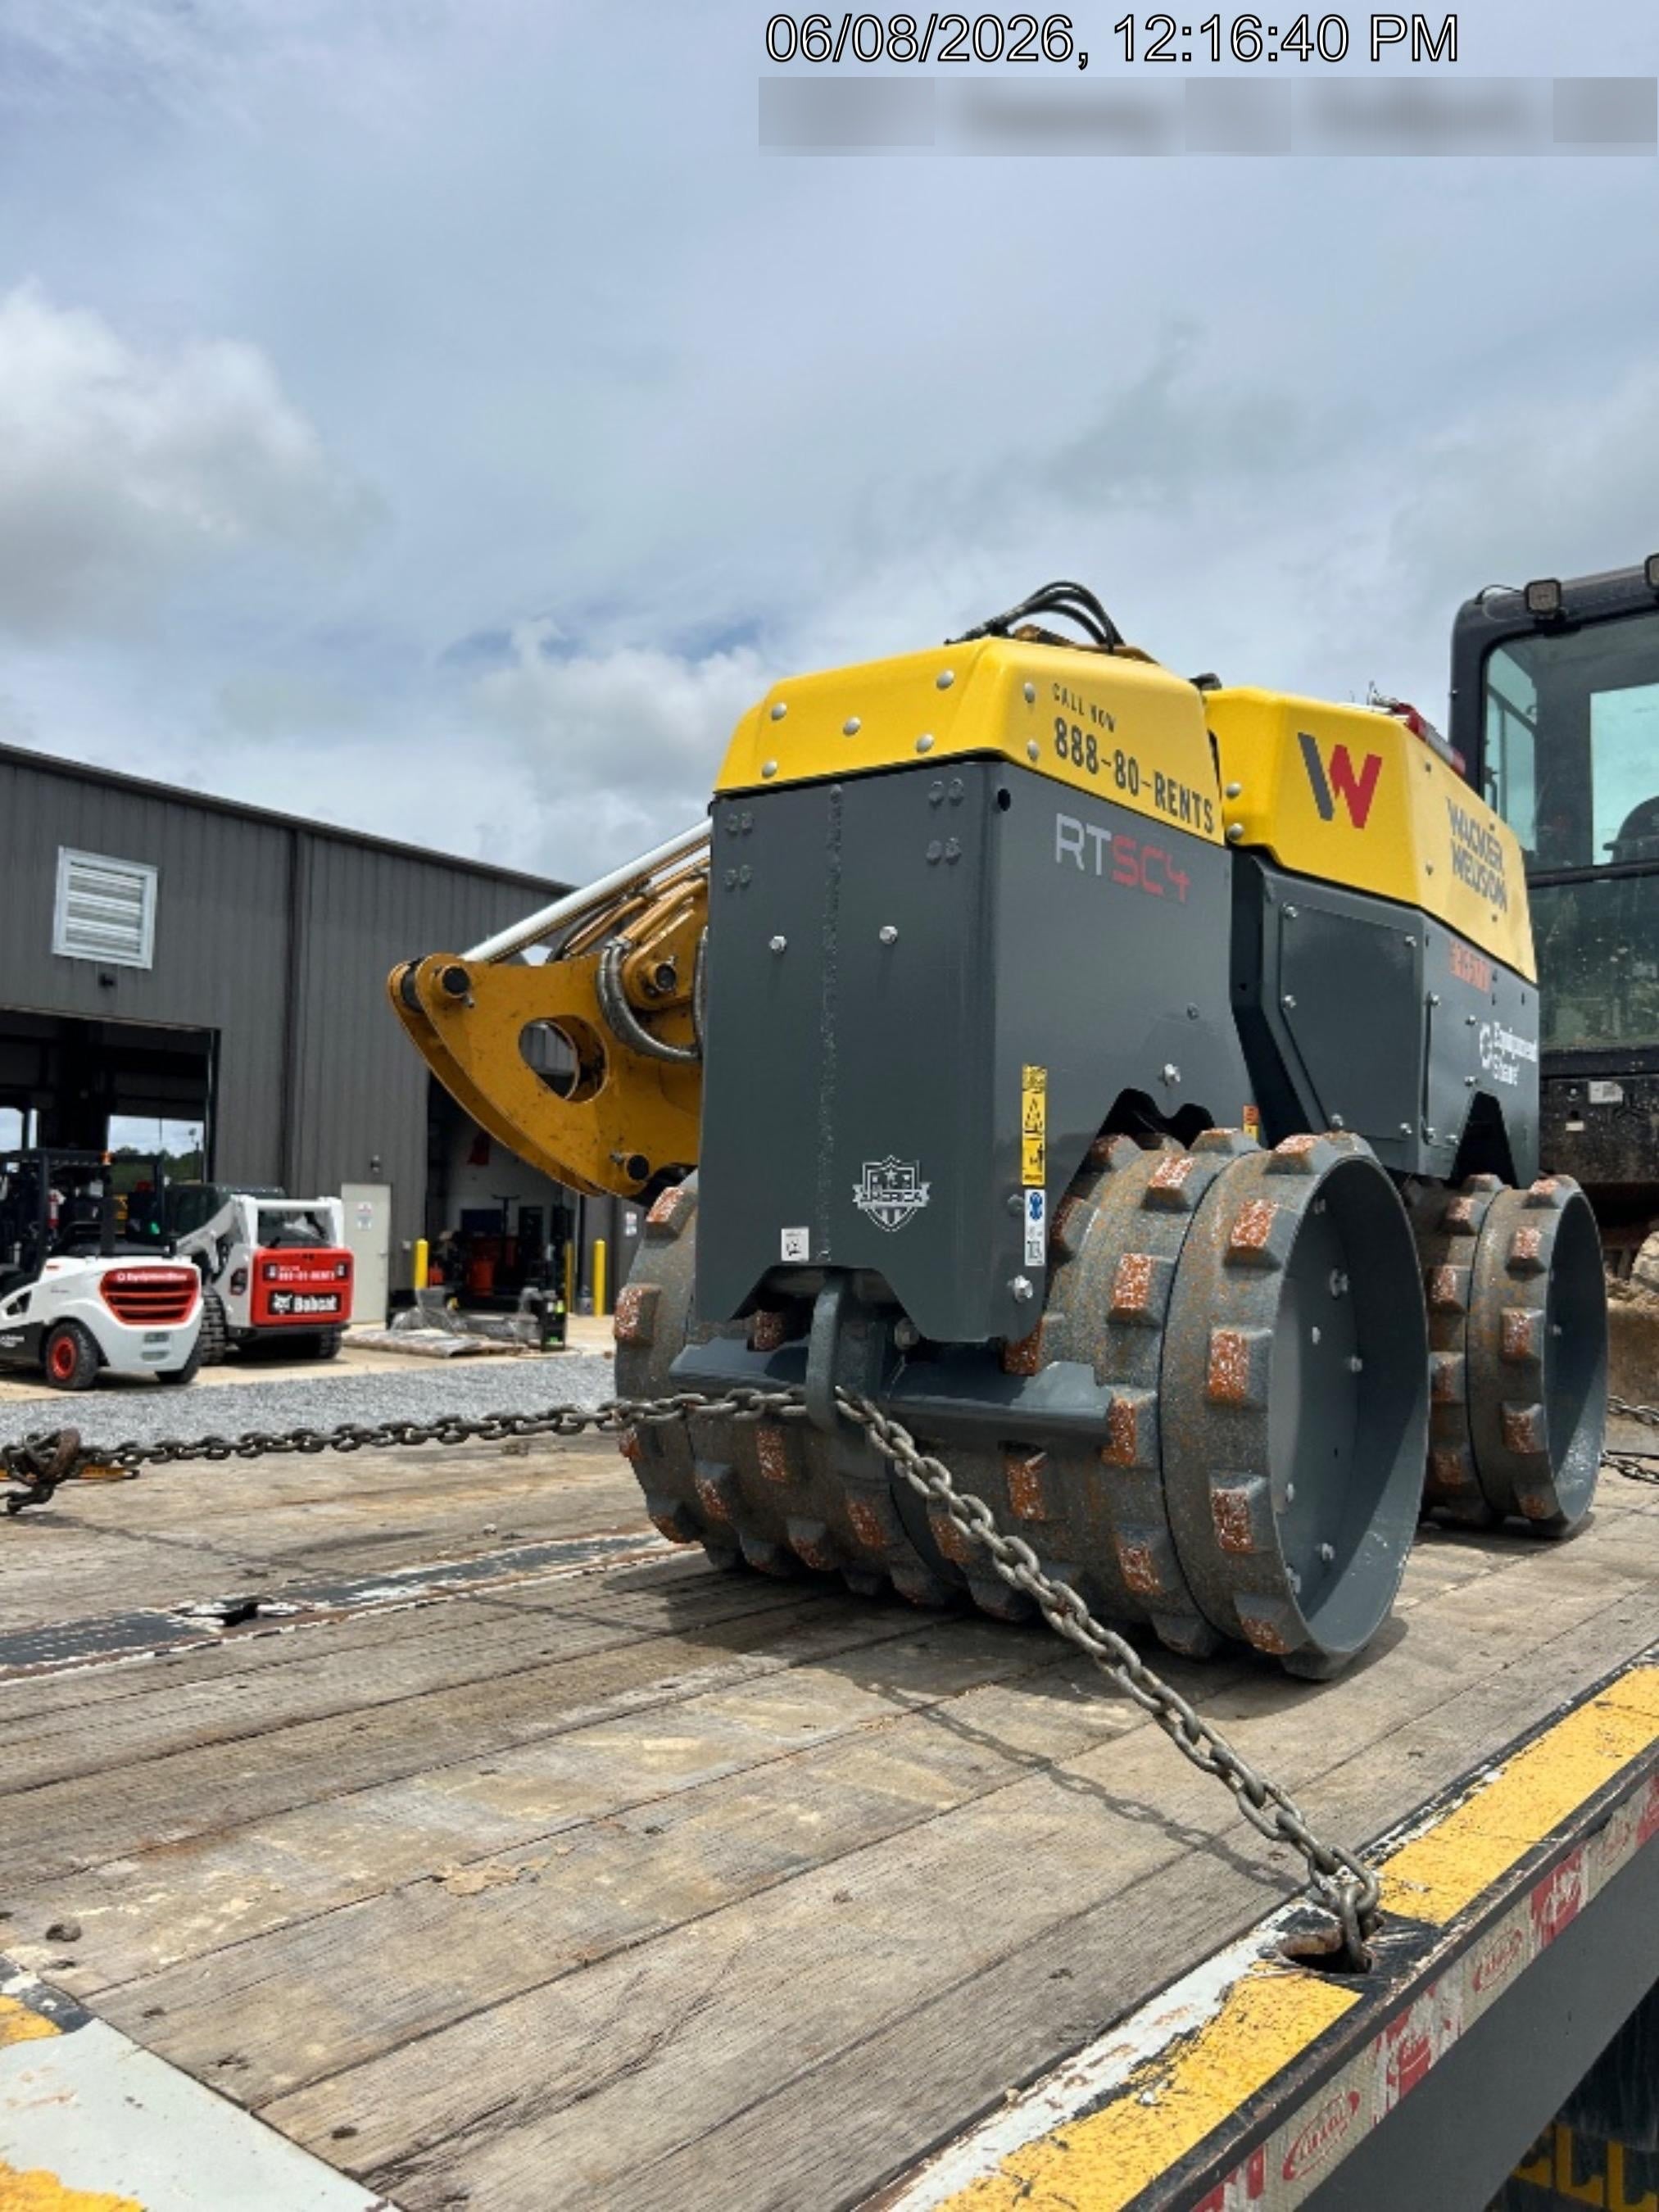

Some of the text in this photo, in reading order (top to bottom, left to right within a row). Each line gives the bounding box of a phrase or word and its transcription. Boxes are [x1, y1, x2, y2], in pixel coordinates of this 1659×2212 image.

[1053, 682, 1117, 733] CALL NOW
[1054, 716, 1214, 835] 888-80-RENTS
[294, 1294, 338, 1313] Bobcat
